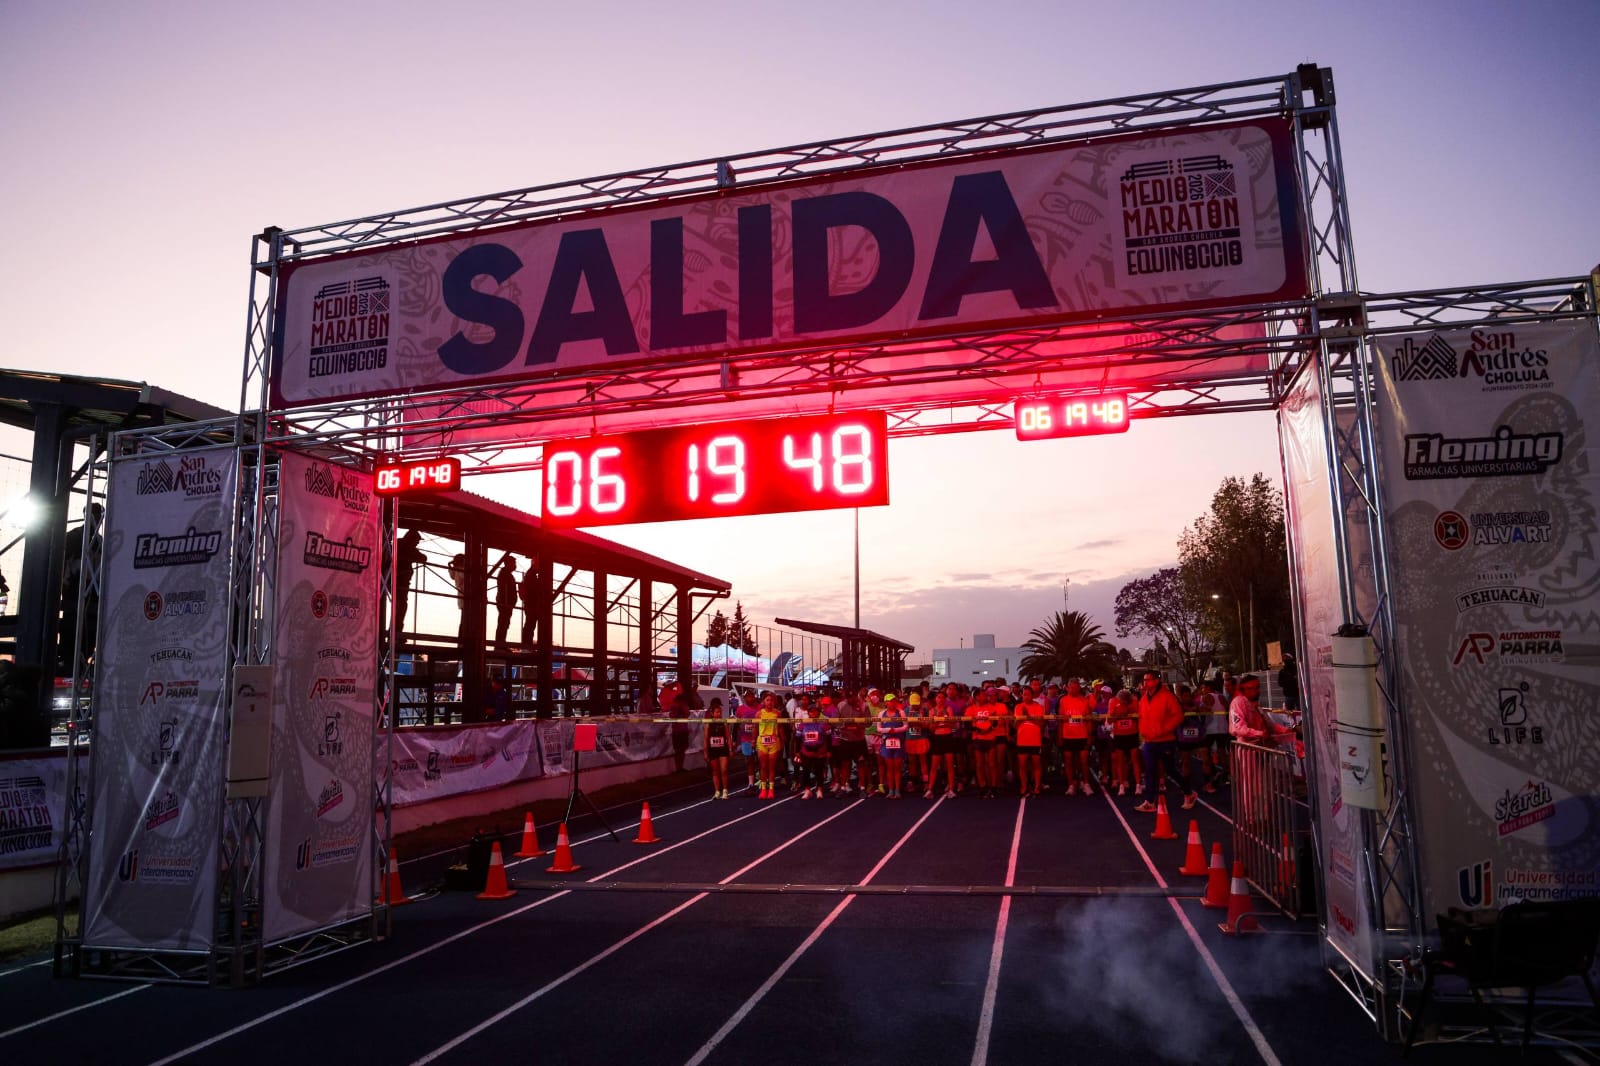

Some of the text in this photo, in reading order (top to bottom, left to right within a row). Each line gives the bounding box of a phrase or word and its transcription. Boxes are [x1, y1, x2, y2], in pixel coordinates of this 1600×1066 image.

[1120, 176, 1188, 208] MEDIO
[1188, 174, 1205, 201] 2026
[1123, 195, 1240, 238] MARATÓN
[1126, 240, 1243, 276] EQUINOCCIO
[437, 170, 1059, 375] SALIDA
[312, 294, 358, 322] MEDIO
[358, 292, 369, 315] 2026
[311, 311, 389, 347] MARATÓN
[1470, 330, 1515, 352] San
[309, 348, 387, 378] EQUINOCCIO
[1459, 347, 1549, 378] Andrés
[1485, 369, 1549, 385] CHOLULA
[1020, 399, 1124, 431] 06 19 48
[1405, 426, 1563, 465] Fleming
[180, 455, 206, 472] San
[546, 425, 873, 517] 06 19 48
[1407, 461, 1538, 477] FARMACIAS UNIVERSITARIAS
[173, 469, 221, 492] Andrés
[377, 463, 452, 490] 06 19 48
[186, 484, 221, 497] CHOLULA
[1470, 511, 1550, 526] UNIVERSIDAD
[135, 527, 222, 559] Fleming
[1473, 524, 1552, 545] ALVART
[305, 533, 371, 568] Fleming
[164, 601, 206, 617] ALVART
[1460, 587, 1541, 608] TEHUACÁN
[1499, 630, 1561, 641] AUTOMOTRIZ
[1500, 640, 1563, 656] PARRA
[166, 687, 199, 699] PARRA
[1488, 727, 1543, 745] LIFE
[1506, 870, 1595, 885] Universidad
